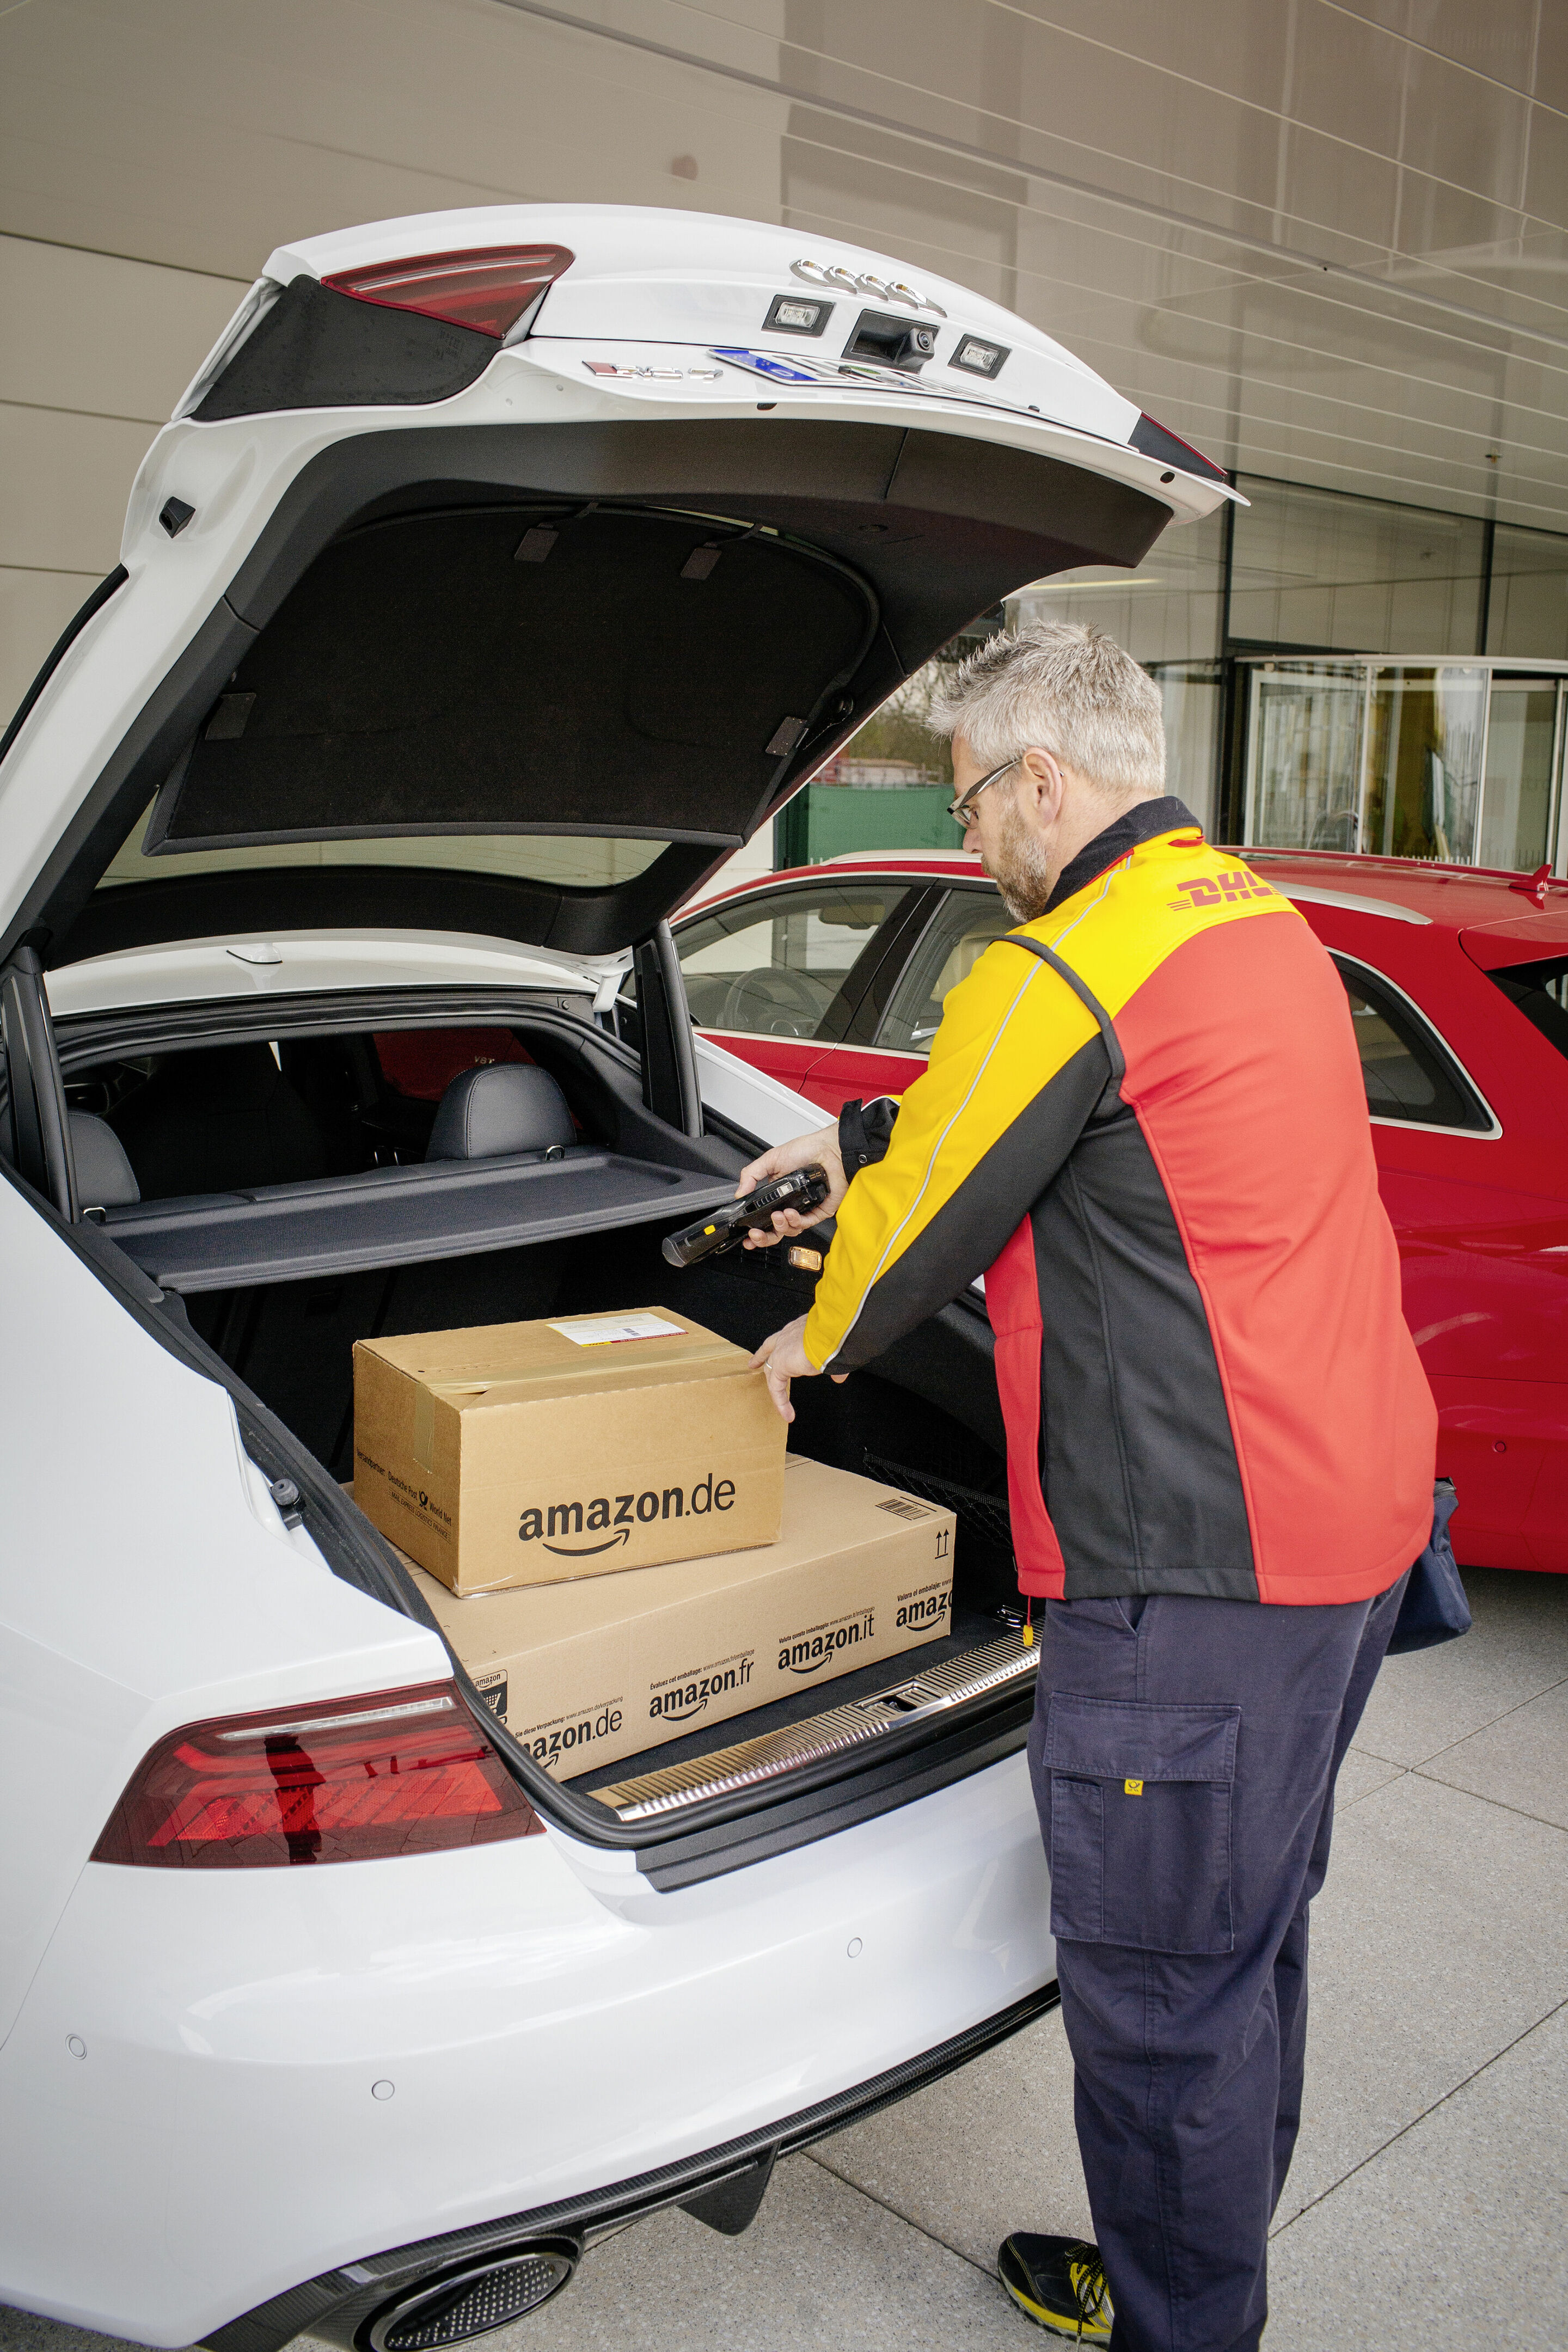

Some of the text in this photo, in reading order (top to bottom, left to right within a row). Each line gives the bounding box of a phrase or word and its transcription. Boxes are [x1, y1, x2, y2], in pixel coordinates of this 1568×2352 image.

[1176, 871, 1273, 907] DHL
[388, 1471, 407, 1492] Deutsche
[408, 1486, 418, 1500] Post
[430, 1500, 443, 1519] World
[443, 1511, 452, 1527] Net
[391, 1491, 448, 1539] MAIL EXPRESS LOGISTICS FINANCE
[518, 1472, 736, 1541] amazon.de
[897, 1592, 912, 1602] Valora
[918, 1582, 941, 1595] embalaje:
[778, 1613, 874, 1670] amazon.it
[779, 1636, 792, 1644] Valuta
[792, 1631, 806, 1640] questo
[475, 1673, 500, 1687] amazon
[650, 1679, 668, 1690] Évaluez
[677, 1667, 702, 1681] emballage:
[650, 1657, 754, 1718] amazon.fr
[523, 1708, 623, 1761] azon.de
[524, 1727, 536, 1735] diese
[537, 1717, 566, 1730] Verpackung:
